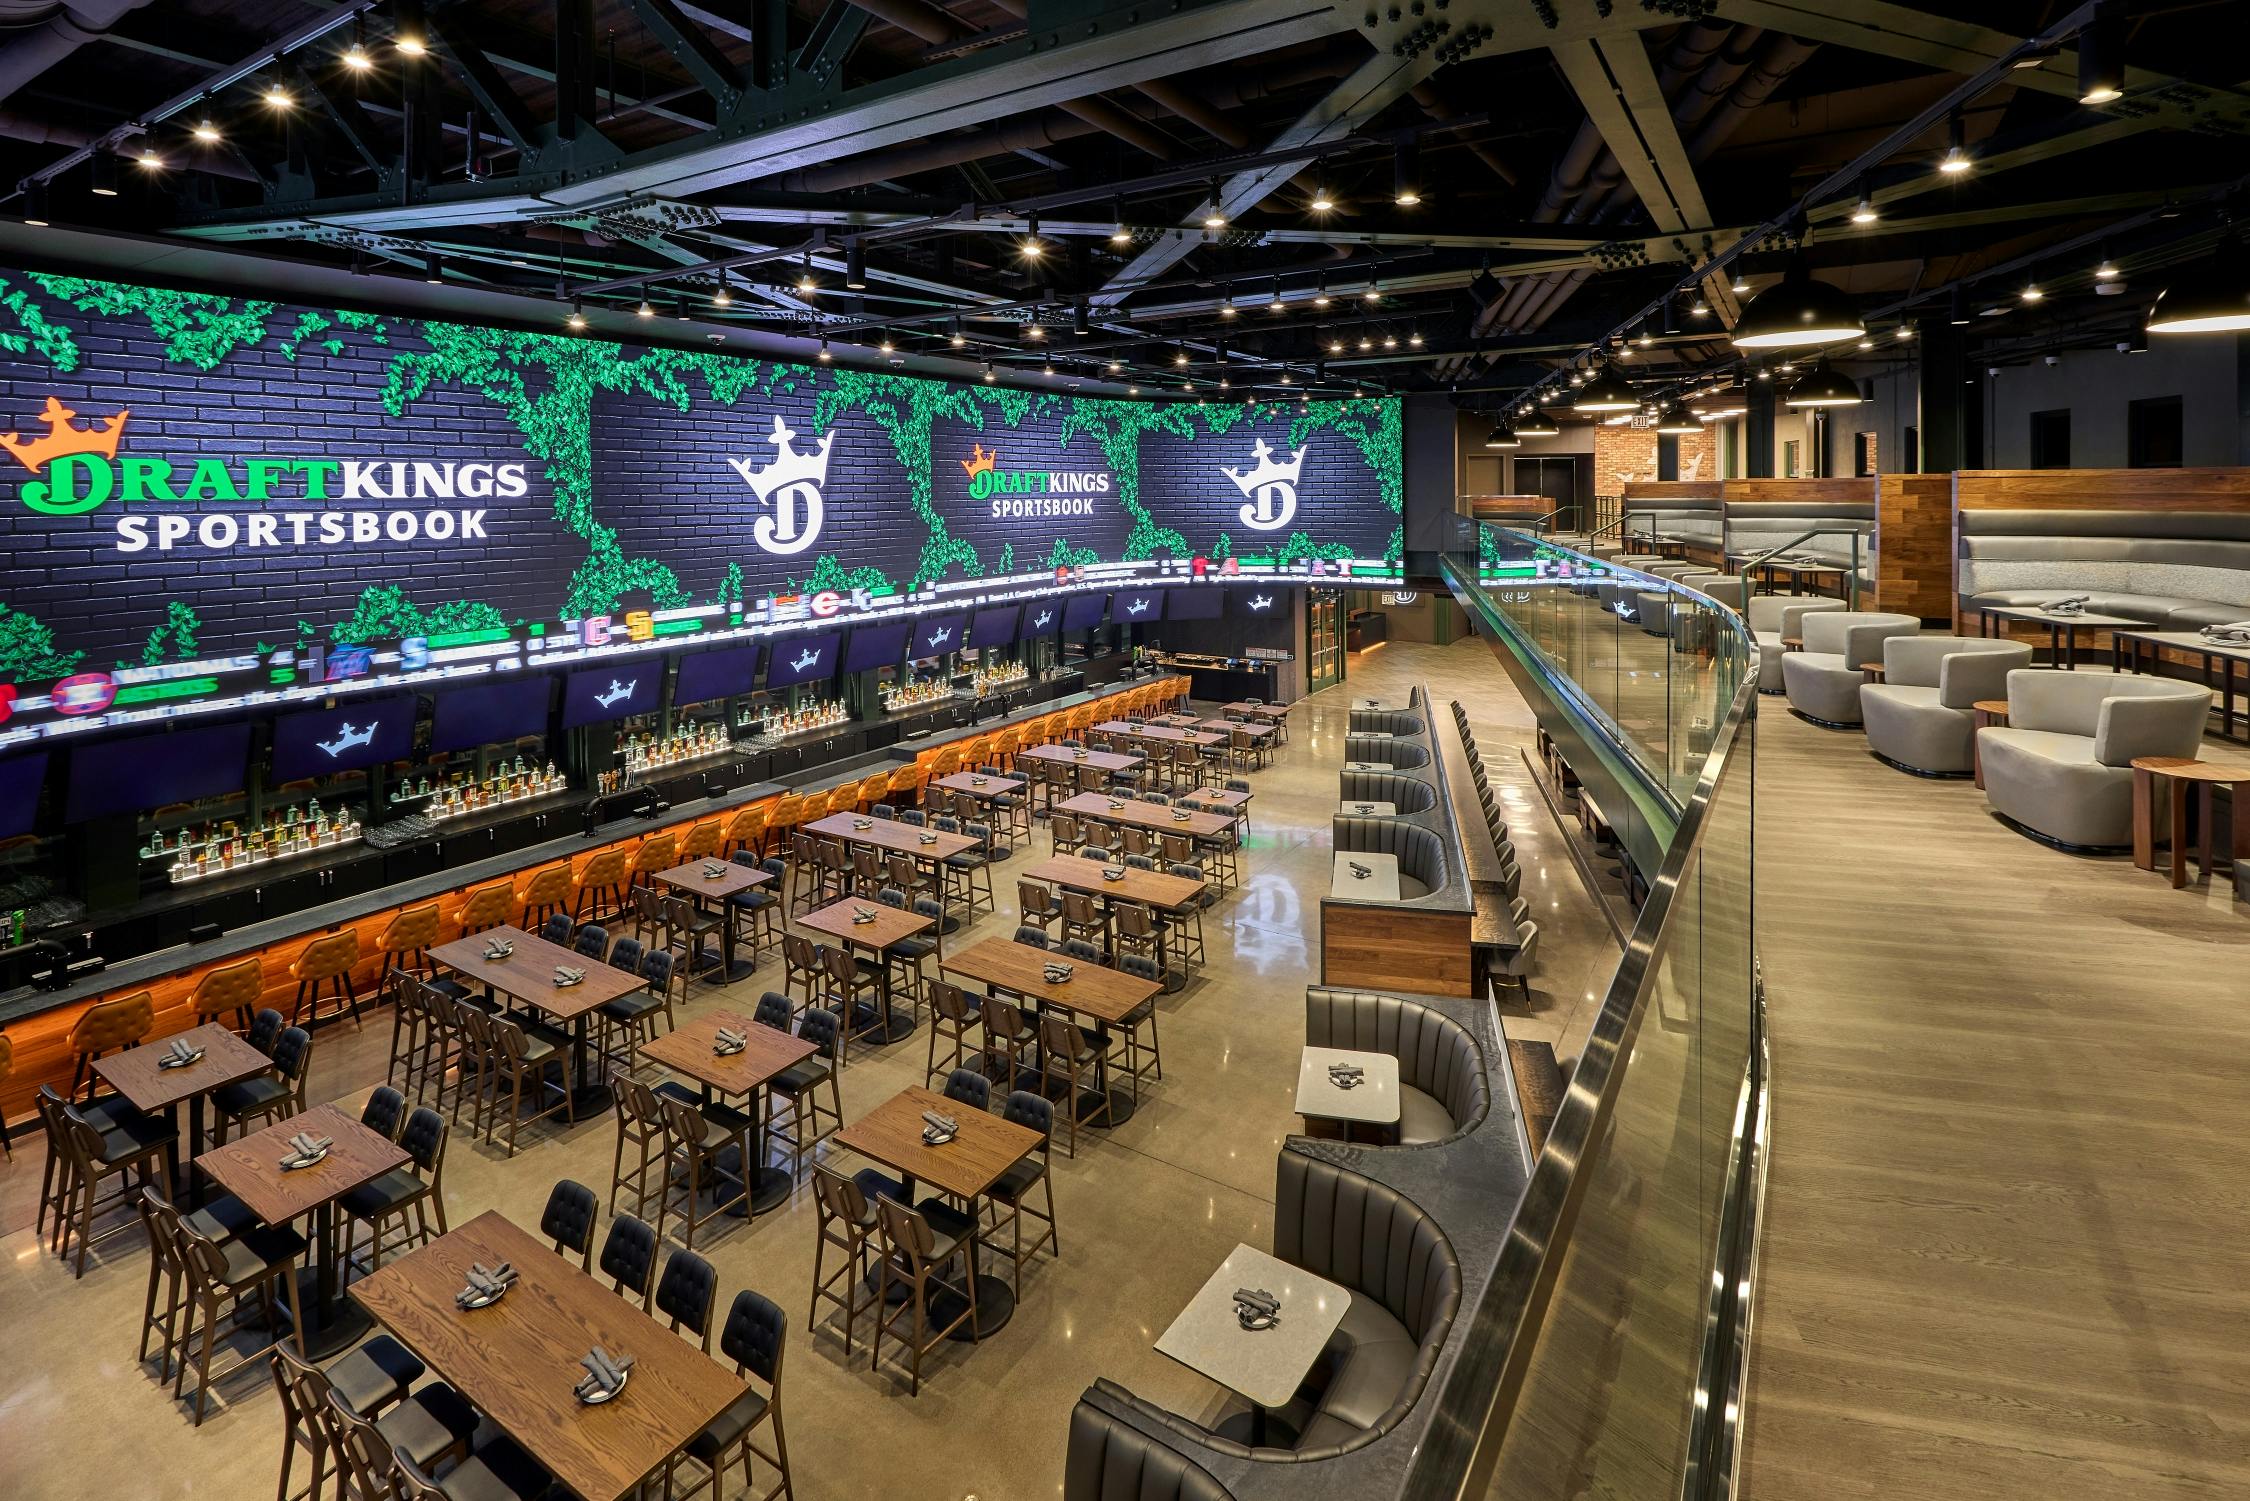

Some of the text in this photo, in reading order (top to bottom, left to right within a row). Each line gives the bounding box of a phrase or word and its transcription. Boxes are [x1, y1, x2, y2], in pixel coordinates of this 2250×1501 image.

[1632, 416, 1648, 426] EXIT
[21, 453, 528, 514] DRAFTKINGS
[969, 470, 1109, 499] DRAFTKINGS
[992, 498, 1094, 518] SPORTSBOOK
[116, 509, 488, 552] SPORTSBOOK
